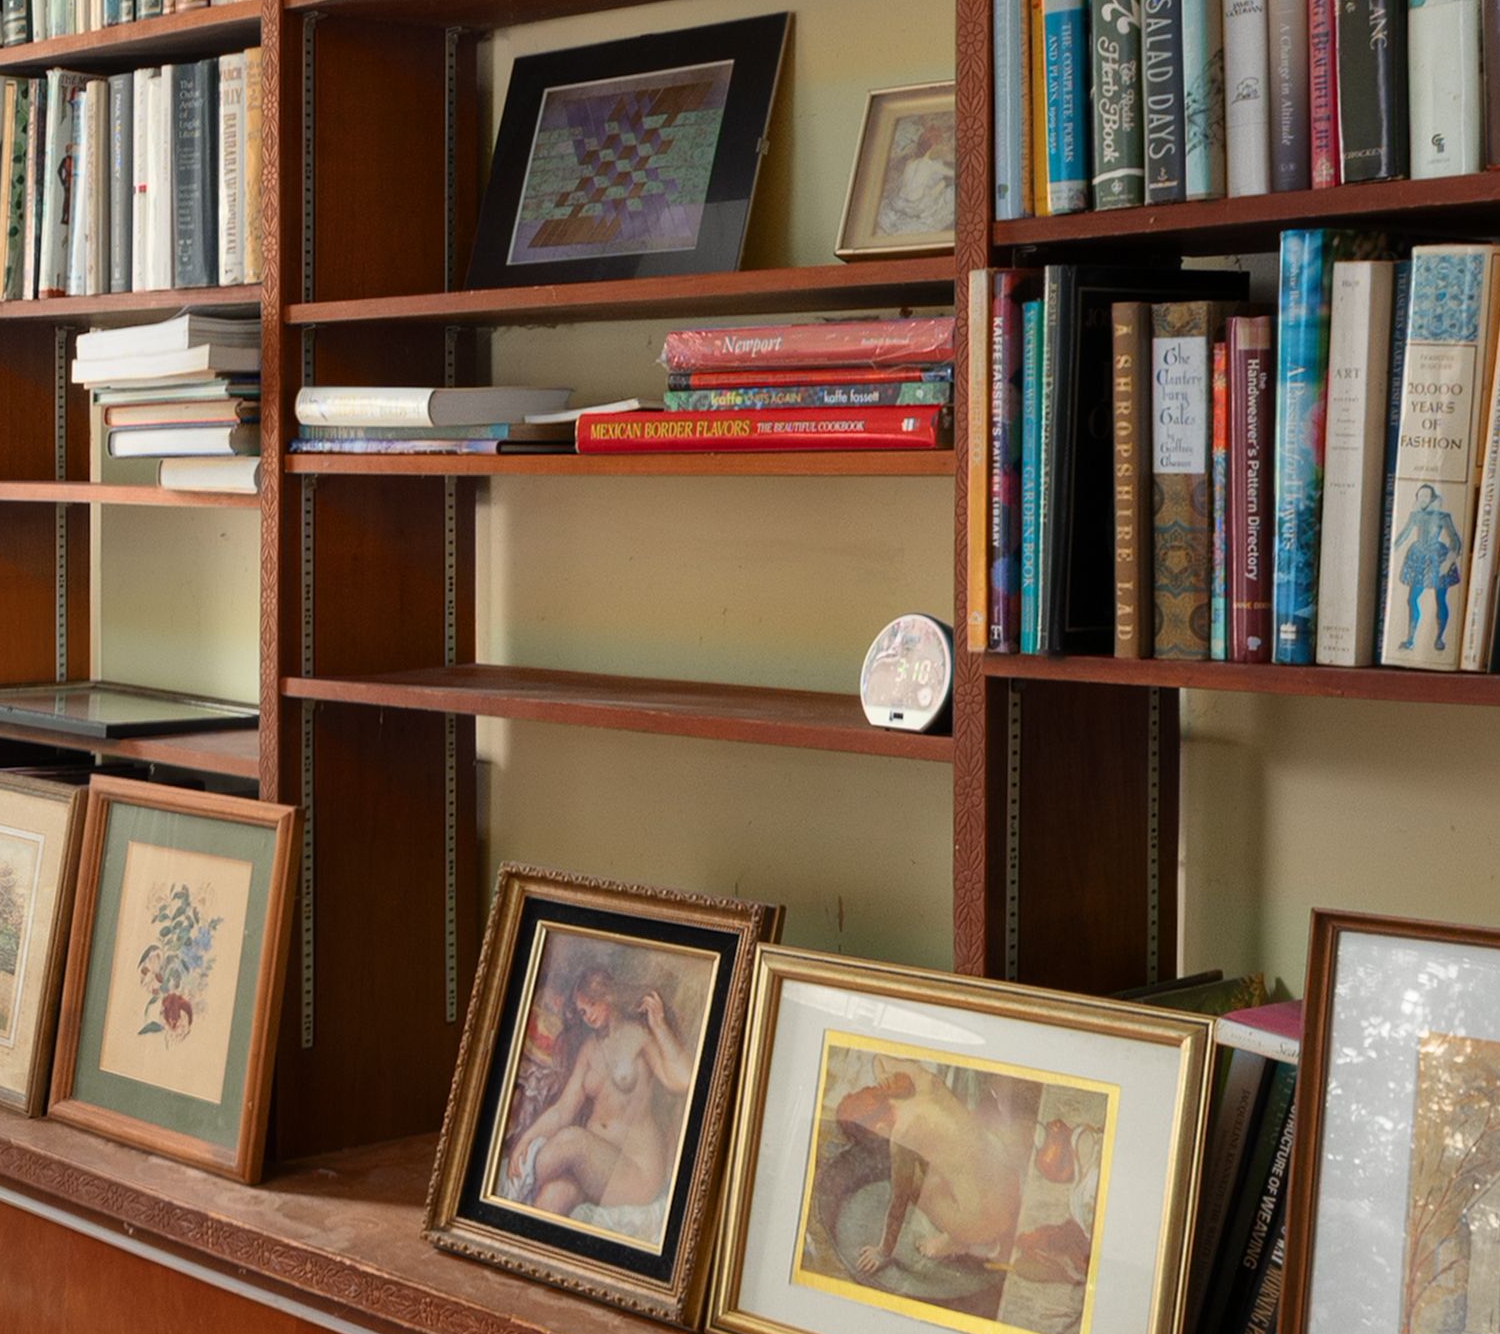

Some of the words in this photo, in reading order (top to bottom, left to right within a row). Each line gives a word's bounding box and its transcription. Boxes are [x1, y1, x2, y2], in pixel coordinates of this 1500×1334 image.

[1061, 22, 1073, 50] THE
[1280, 23, 1292, 34] A
[1098, 36, 1119, 98] Herb
[1121, 59, 1136, 86] The
[1278, 35, 1293, 79] Change
[1062, 52, 1073, 118] COMPLETE
[1280, 82, 1293, 95] in
[1099, 99, 1120, 164] Book
[1121, 89, 1136, 132] Rodale
[1147, 93, 1175, 159] DAYS
[1281, 98, 1294, 146] Altitude
[1063, 122, 1075, 163] POEMS
[721, 335, 784, 357] Newport
[993, 316, 1003, 360] KAFFE
[1115, 323, 1133, 337] A
[823, 390, 848, 403] kaffe
[850, 388, 879, 402] fassett
[1258, 371, 1267, 390] the
[1334, 369, 1360, 380] ART
[1408, 382, 1463, 396] 20,000
[992, 364, 1003, 437] FASSETT'S
[1246, 358, 1260, 457] Handweaver's
[1411, 400, 1456, 414] YEARS
[590, 422, 640, 441] MEXICAN
[645, 422, 692, 438] BORDER
[696, 420, 750, 437] FLAVORS
[757, 422, 772, 432] THE
[773, 421, 817, 433] BEAUTIFUL
[819, 420, 864, 432] COOKBOOK
[1400, 435, 1462, 450] FASHION
[1421, 418, 1441, 431] OF
[993, 440, 1001, 493] PATTERN
[1115, 354, 1134, 562] SHROPSHIRE
[1023, 466, 1035, 540] GARDEN
[1246, 459, 1259, 513] Pattern
[1485, 482, 1497, 502] AND
[993, 496, 1001, 548] LIBRARY
[1023, 543, 1034, 588] BOOK
[1244, 516, 1259, 580] Directory
[1116, 581, 1134, 641] LAD
[1266, 1176, 1282, 1195] OF
[1242, 1195, 1278, 1269] WEAVING
[1250, 1266, 1282, 1325] MORNING
